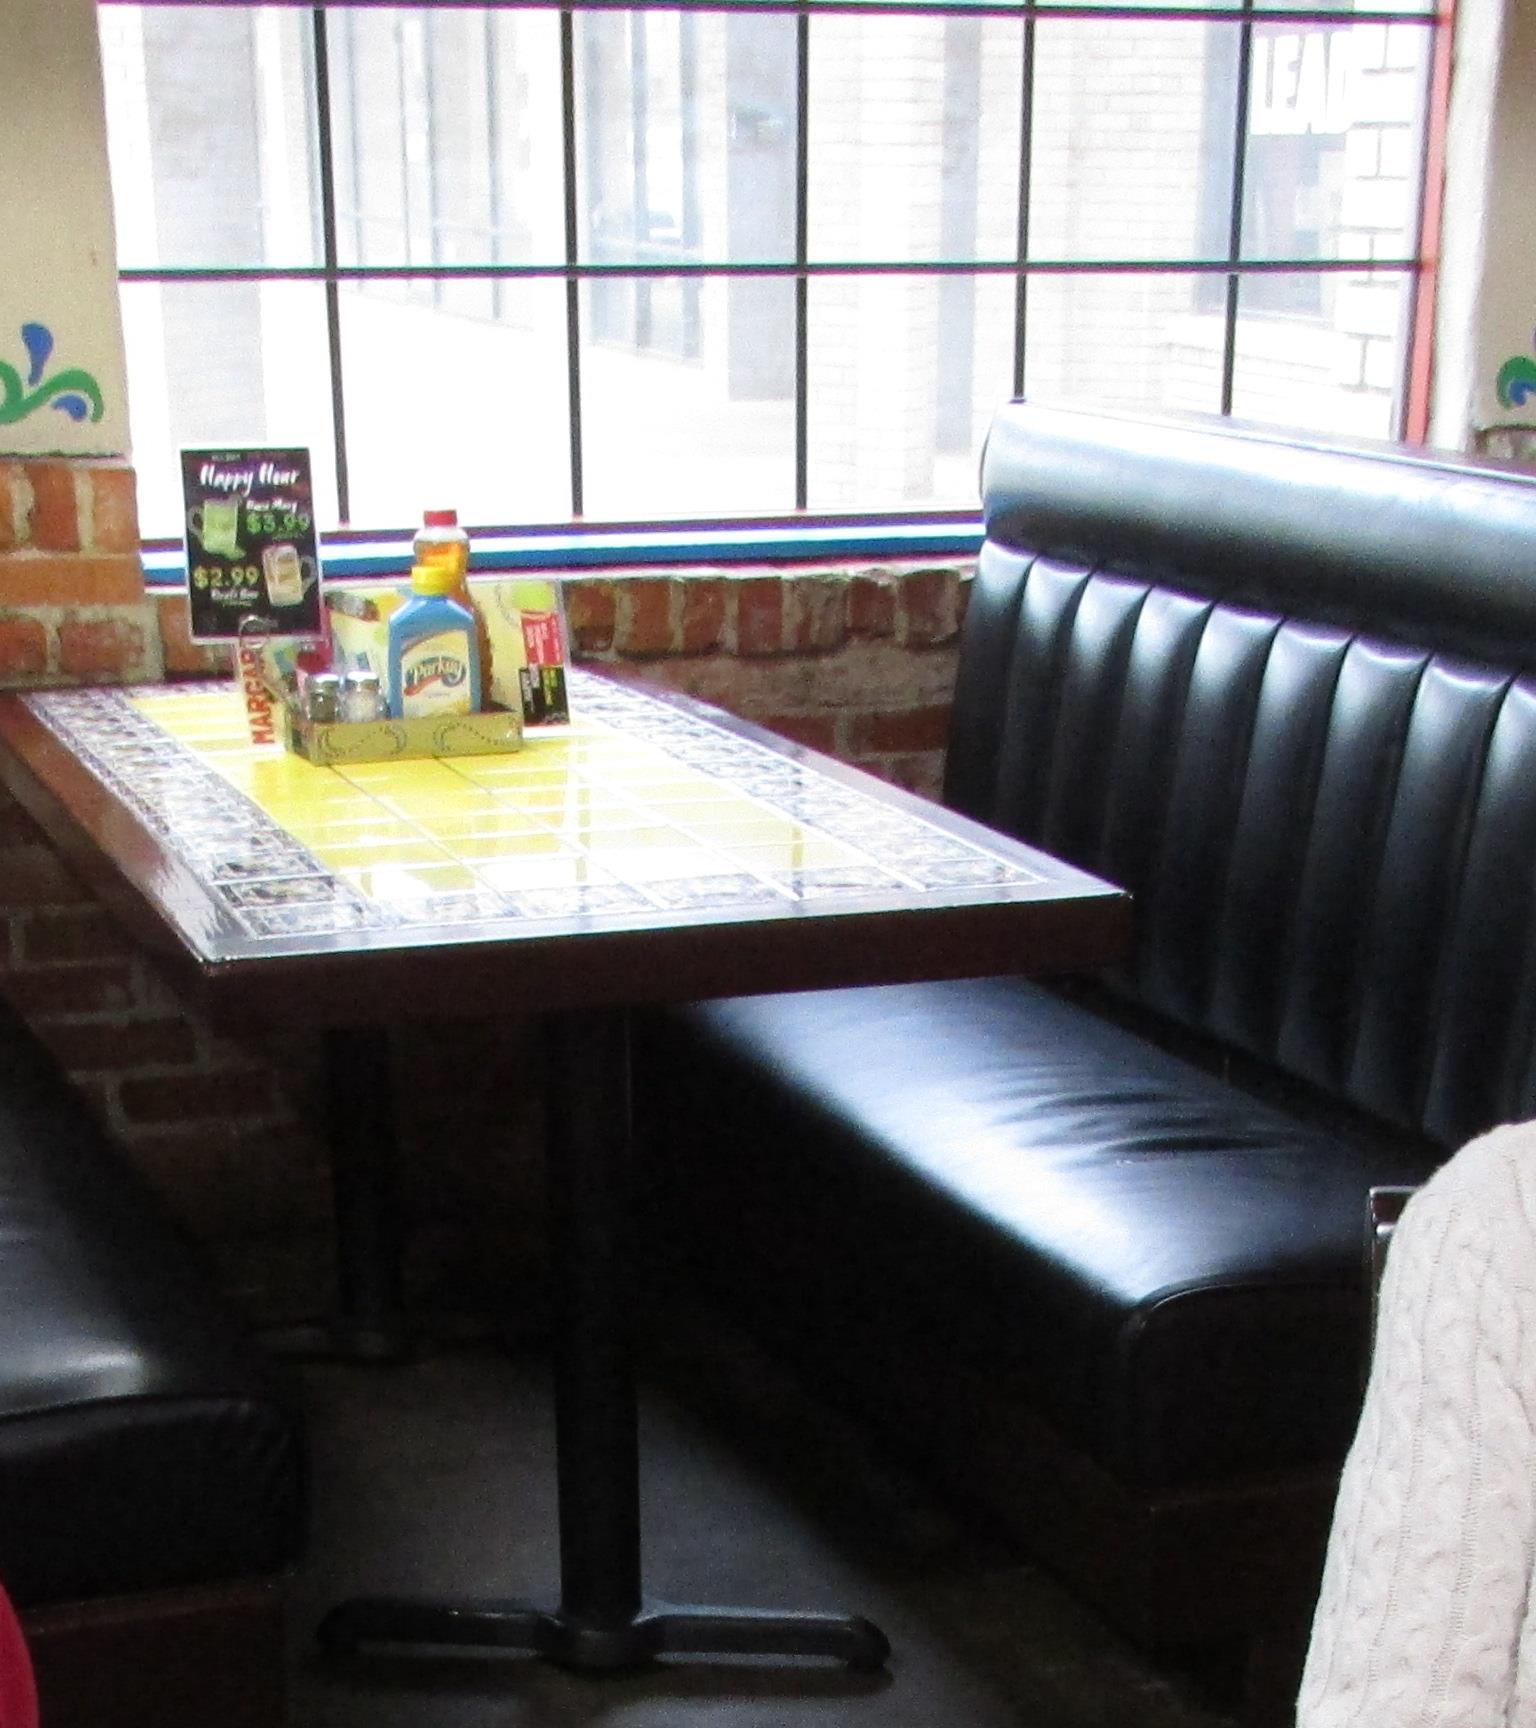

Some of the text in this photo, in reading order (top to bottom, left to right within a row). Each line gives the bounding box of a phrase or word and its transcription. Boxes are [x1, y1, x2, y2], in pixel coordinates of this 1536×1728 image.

[200, 462, 300, 498] Happy Hour
[194, 566, 260, 590] $2.99
